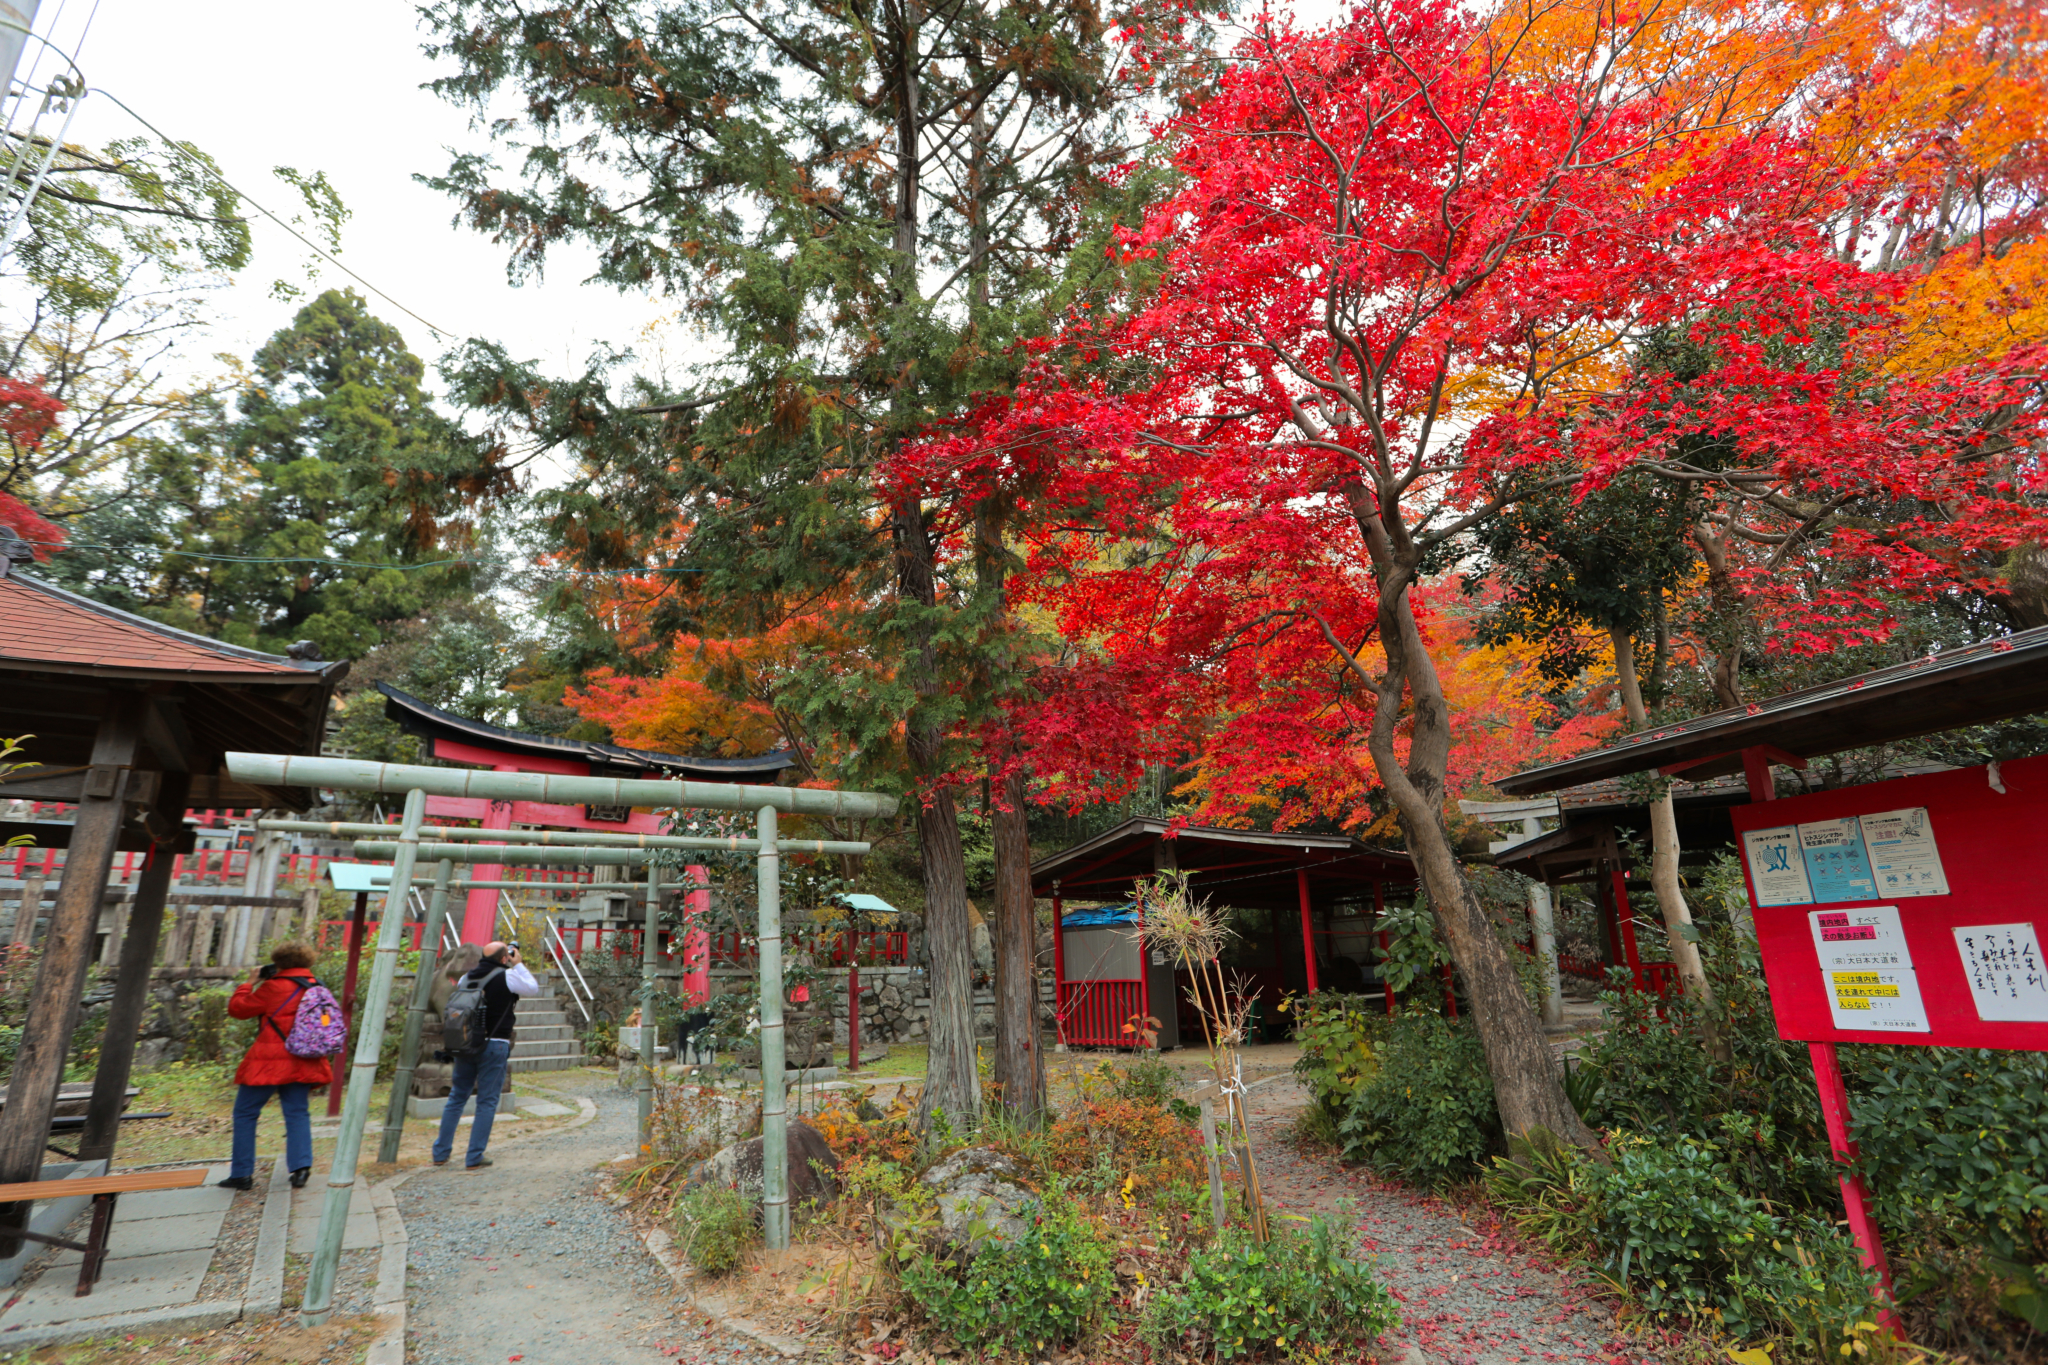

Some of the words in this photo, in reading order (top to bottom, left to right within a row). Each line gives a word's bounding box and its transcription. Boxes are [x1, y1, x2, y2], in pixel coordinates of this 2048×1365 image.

[1865, 822, 1903, 830] ヒトスジシマカに
[1804, 832, 1843, 841] ヒトスジシマカの
[1762, 843, 1790, 872] 蚊
[1819, 918, 1849, 926] 境内地内
[1836, 988, 1900, 996] 犬を連れて中には
